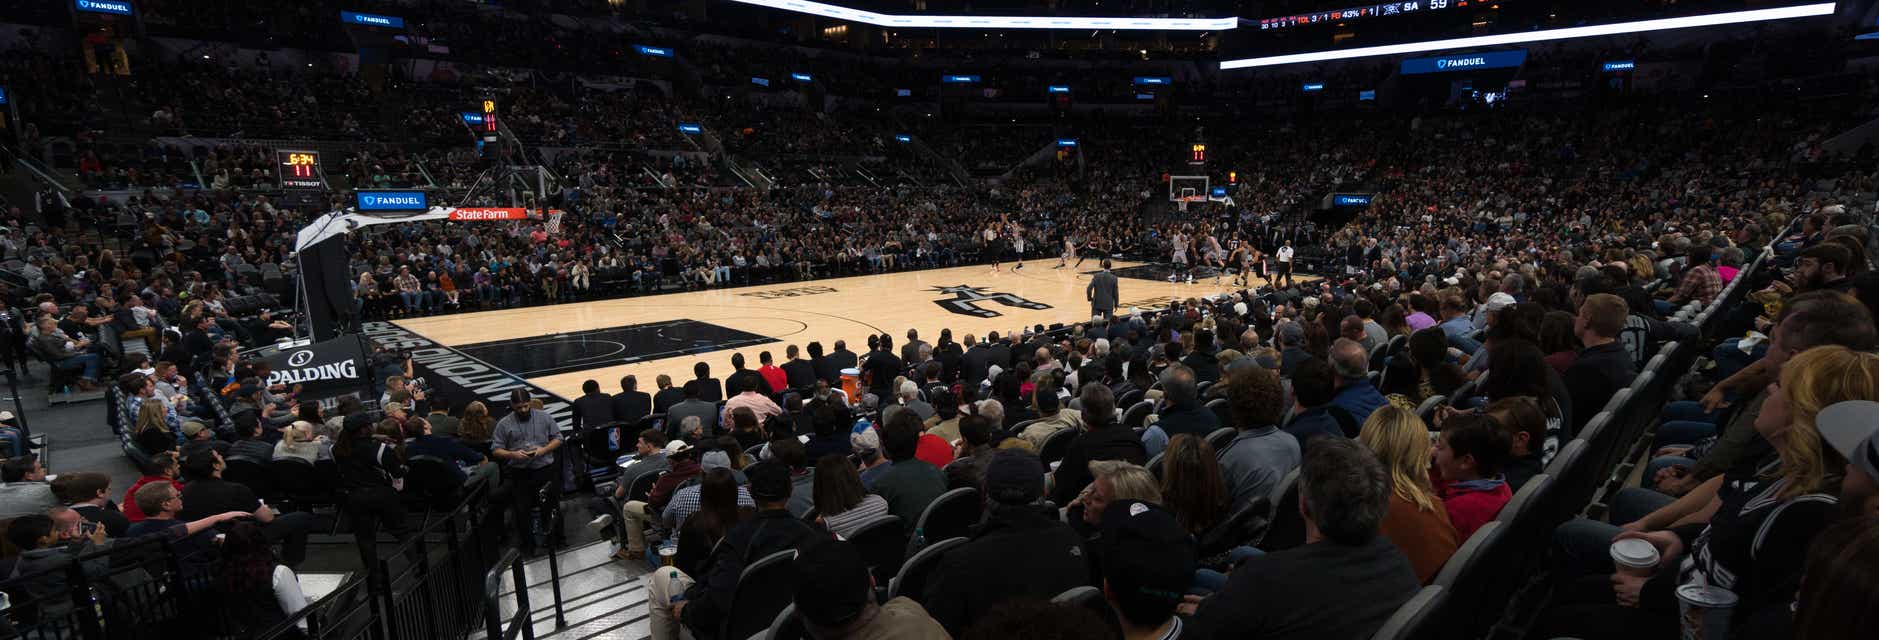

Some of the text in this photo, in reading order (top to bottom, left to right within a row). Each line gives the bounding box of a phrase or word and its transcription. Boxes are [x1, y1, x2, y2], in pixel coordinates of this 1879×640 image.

[90, 2, 128, 12] FANDUEL
[1342, 10, 1360, 18] 43%
[1403, 2, 1419, 11] SA
[1430, 0, 1447, 9] 59
[1447, 57, 1486, 67] FANDUEL
[290, 153, 314, 165] 6:34
[295, 164, 310, 176] 11
[377, 197, 421, 205] FANDUEL
[266, 359, 357, 387] PALDING
